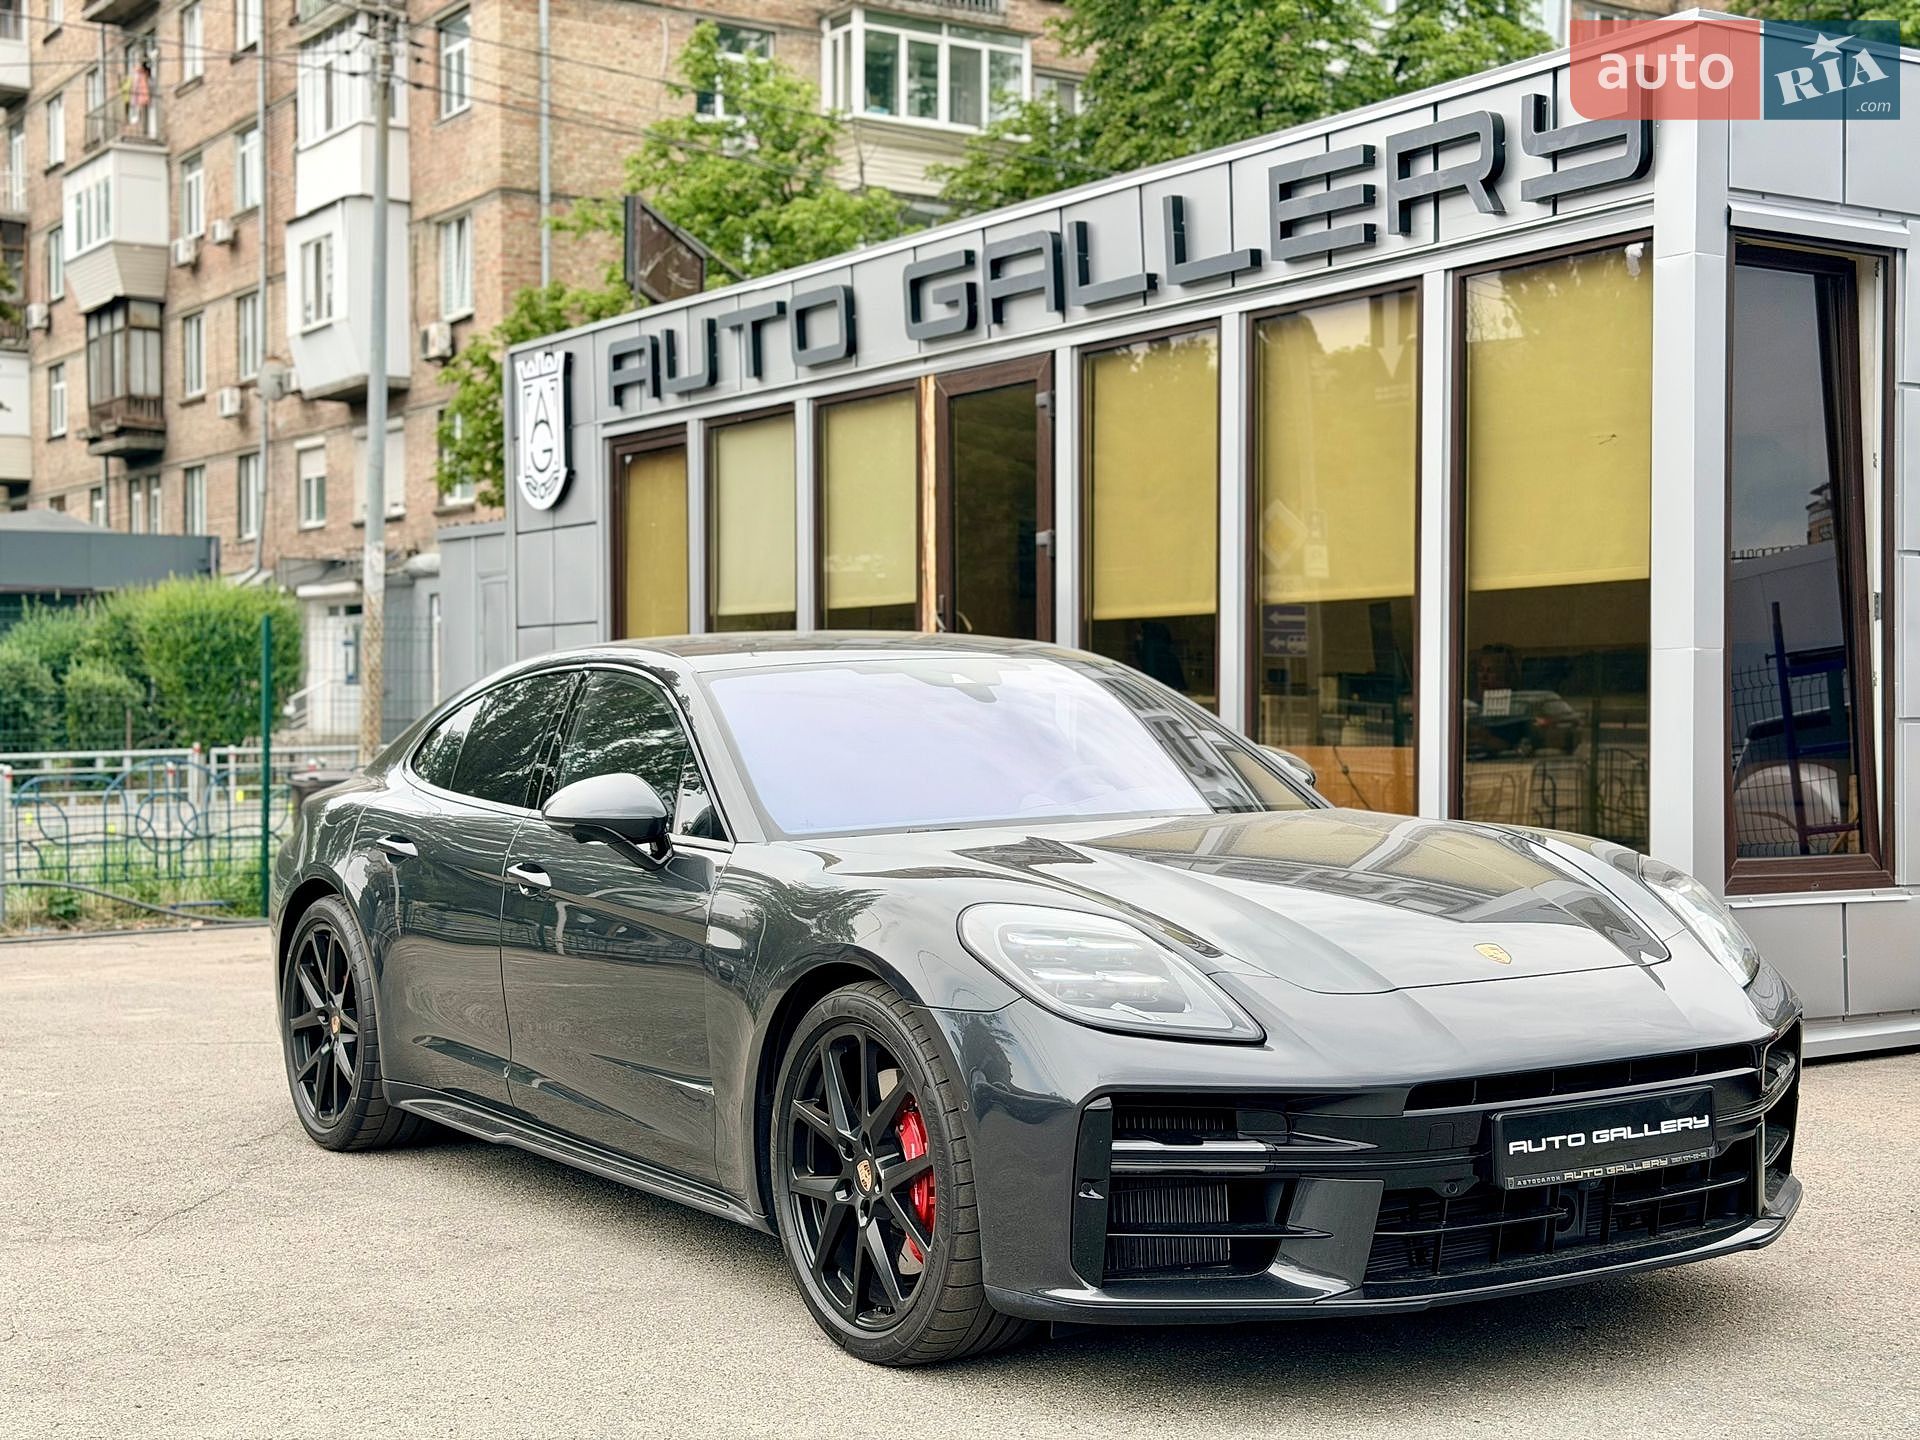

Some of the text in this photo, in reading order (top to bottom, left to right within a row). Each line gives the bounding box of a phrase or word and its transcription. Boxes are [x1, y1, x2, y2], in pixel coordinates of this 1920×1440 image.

[607, 64, 1654, 408] AUTO GALLERY
[1509, 1115, 1709, 1155] AUTO GALLERY
[1564, 1168, 1603, 1180] AUTO
[1606, 1157, 1668, 1175] GALLERY
